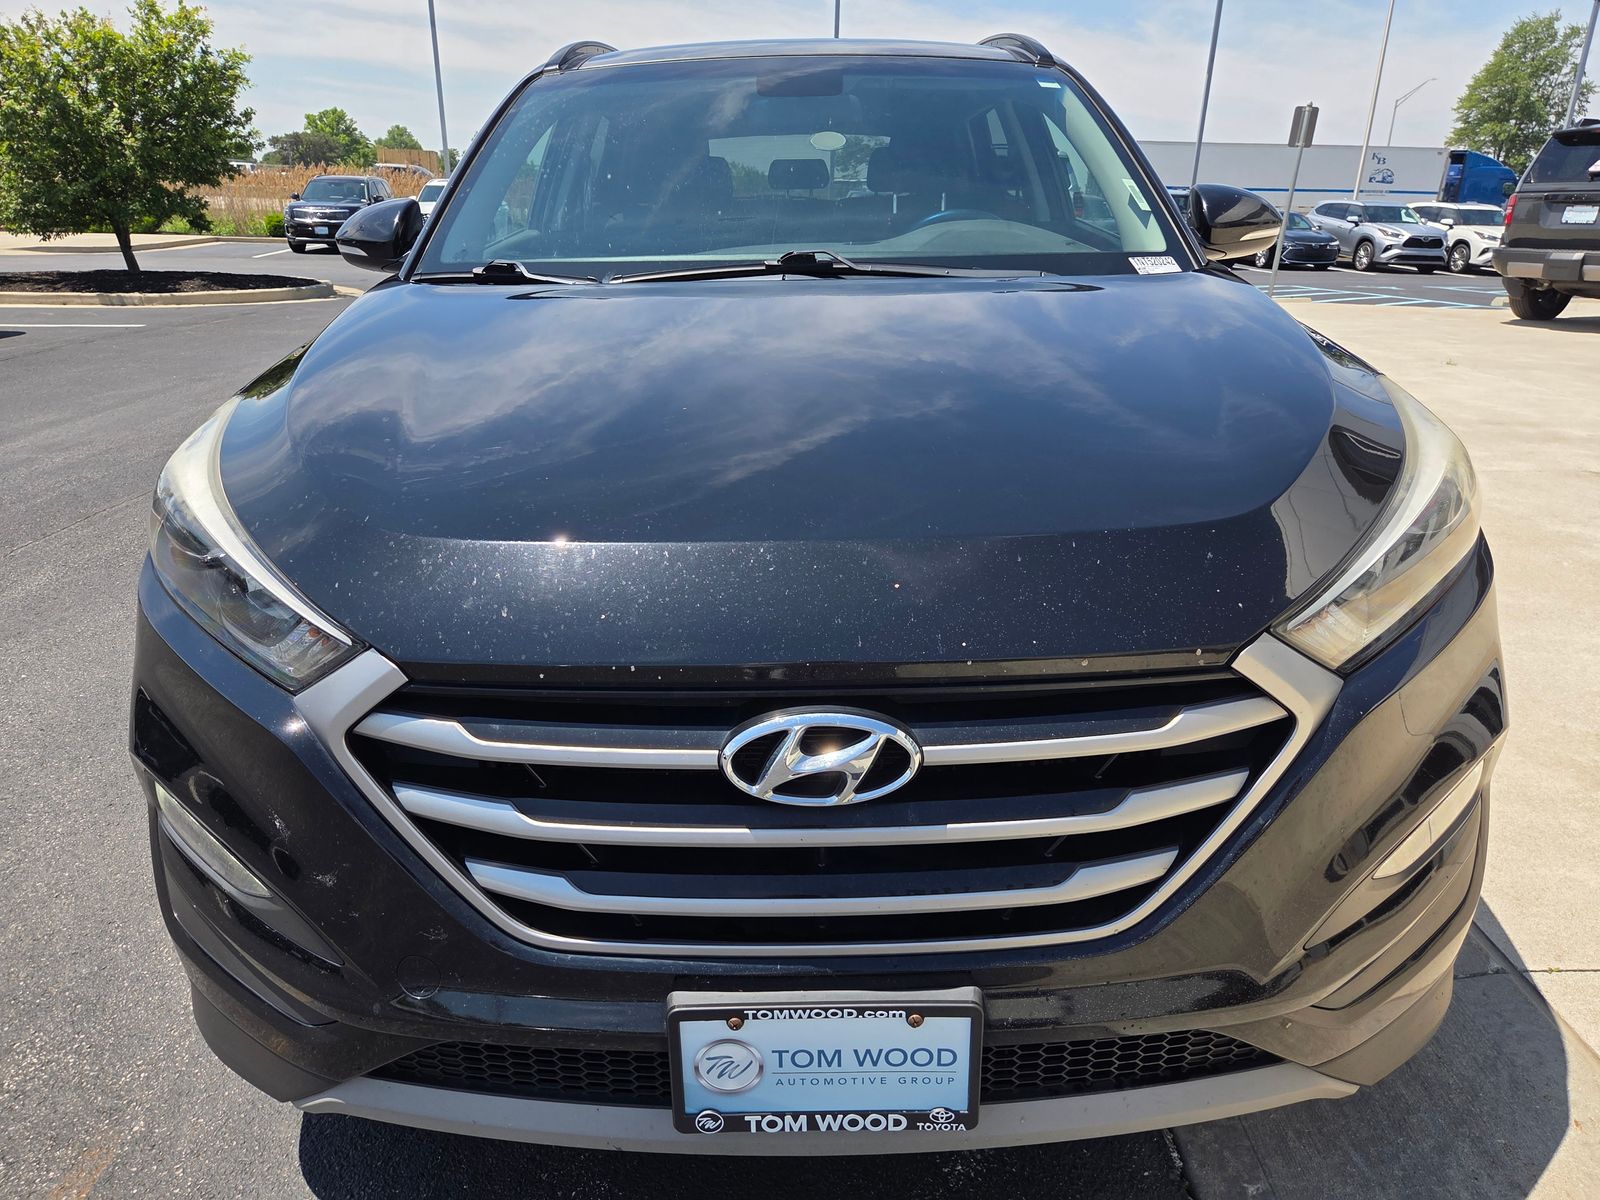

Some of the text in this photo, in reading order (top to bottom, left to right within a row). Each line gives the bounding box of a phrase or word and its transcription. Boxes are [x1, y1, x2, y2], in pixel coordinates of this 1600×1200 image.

[744, 1009, 906, 1020] TOMWOOD.com
[772, 1047, 958, 1069] TOM WOOD
[705, 1054, 753, 1080] TW
[775, 1075, 955, 1087] AUTOMOTIVE GROUP
[744, 1114, 908, 1133] TOM WOOD
[917, 1123, 967, 1132] TOYOTA
